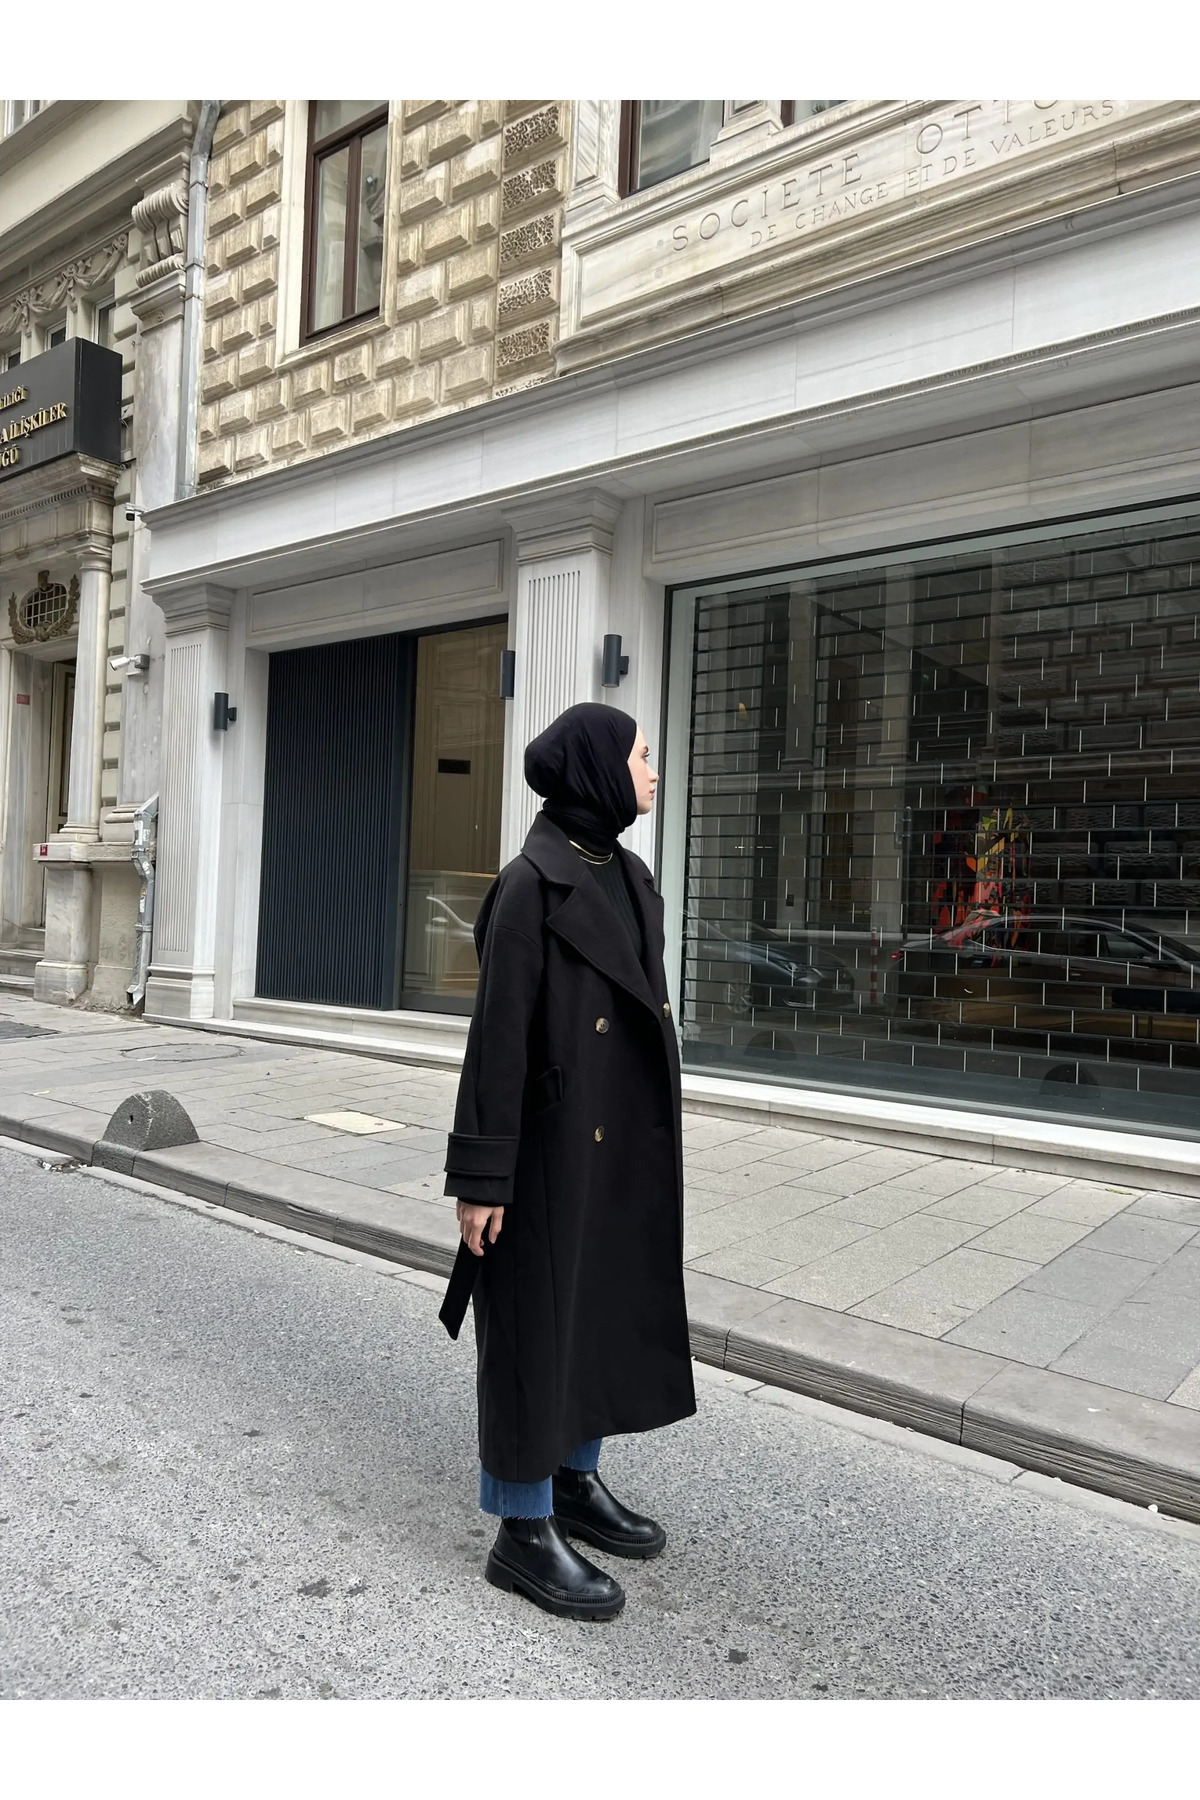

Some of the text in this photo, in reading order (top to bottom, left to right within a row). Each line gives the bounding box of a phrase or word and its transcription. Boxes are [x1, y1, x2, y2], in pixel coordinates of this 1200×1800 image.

[751, 100, 1113, 248] DE CHANGE ET DE VALEURS
